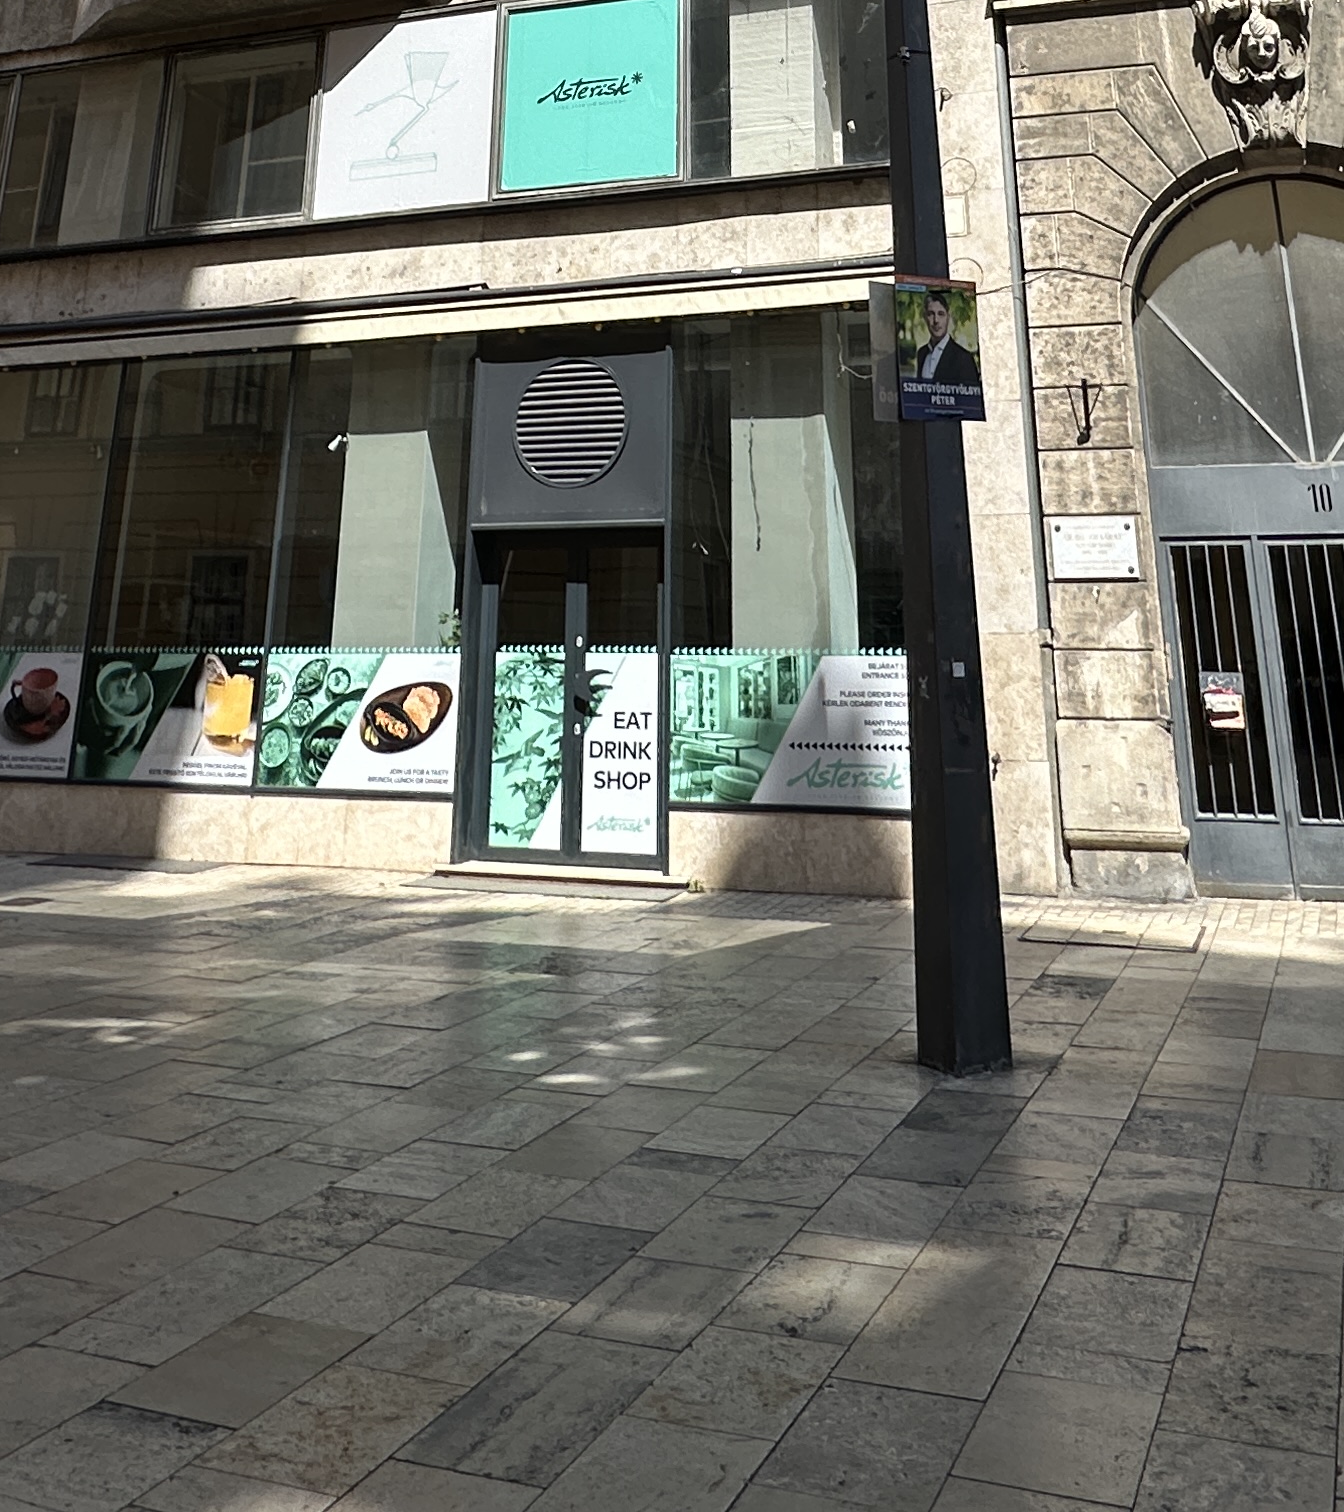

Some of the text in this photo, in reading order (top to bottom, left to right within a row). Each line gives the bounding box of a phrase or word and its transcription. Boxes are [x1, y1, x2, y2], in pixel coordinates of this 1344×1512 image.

[537, 75, 632, 104] Asterisk
[931, 394, 955, 405] PÉTER
[1308, 483, 1333, 513] 10
[862, 672, 899, 680] ENTRANCE
[840, 690, 865, 698] PLEASE
[867, 690, 891, 698] ORDER
[614, 712, 652, 730] EAT
[864, 719, 908, 727] MANY THAN
[589, 740, 651, 760] DRINK
[594, 770, 651, 790] SHOP
[786, 757, 905, 790] Asterisk
